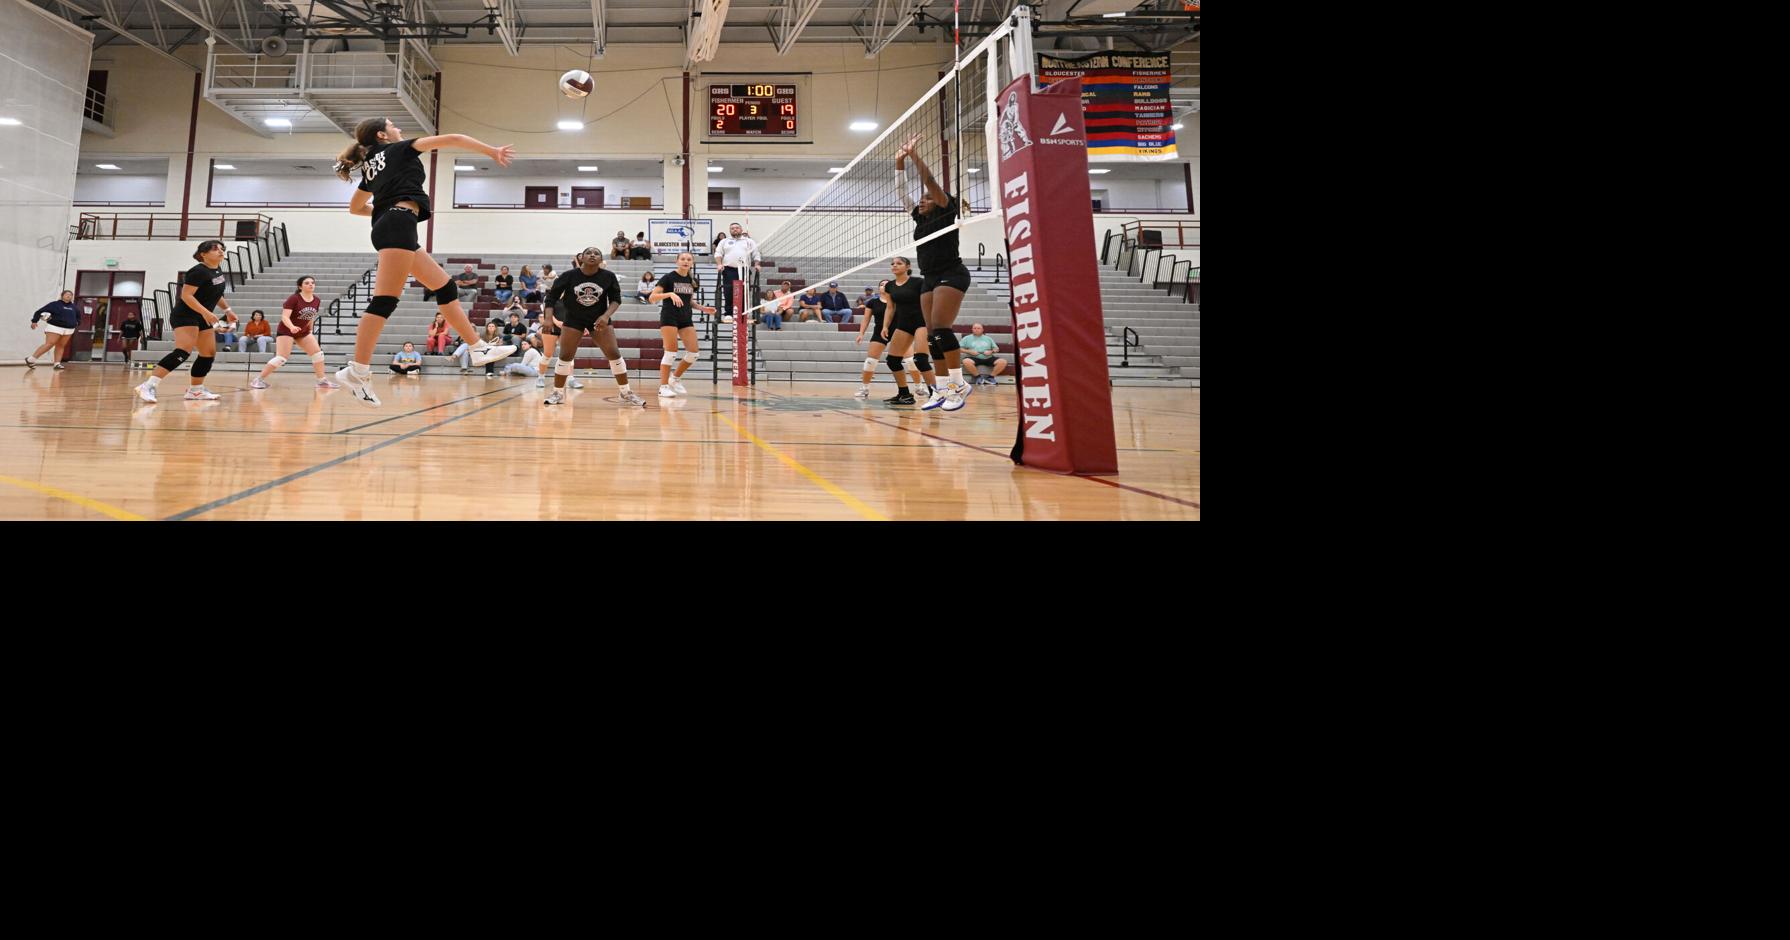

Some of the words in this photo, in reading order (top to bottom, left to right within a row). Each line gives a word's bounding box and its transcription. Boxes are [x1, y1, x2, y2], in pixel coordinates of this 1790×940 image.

[1112, 56, 1168, 68] CONFERENCE
[747, 85, 773, 97] 1:00
[716, 104, 735, 116] 20
[750, 105, 758, 115] 3
[781, 104, 794, 115] 19
[716, 120, 724, 129] 2
[786, 120, 794, 130] 0
[1004, 171, 1057, 443] FISHERMEN
